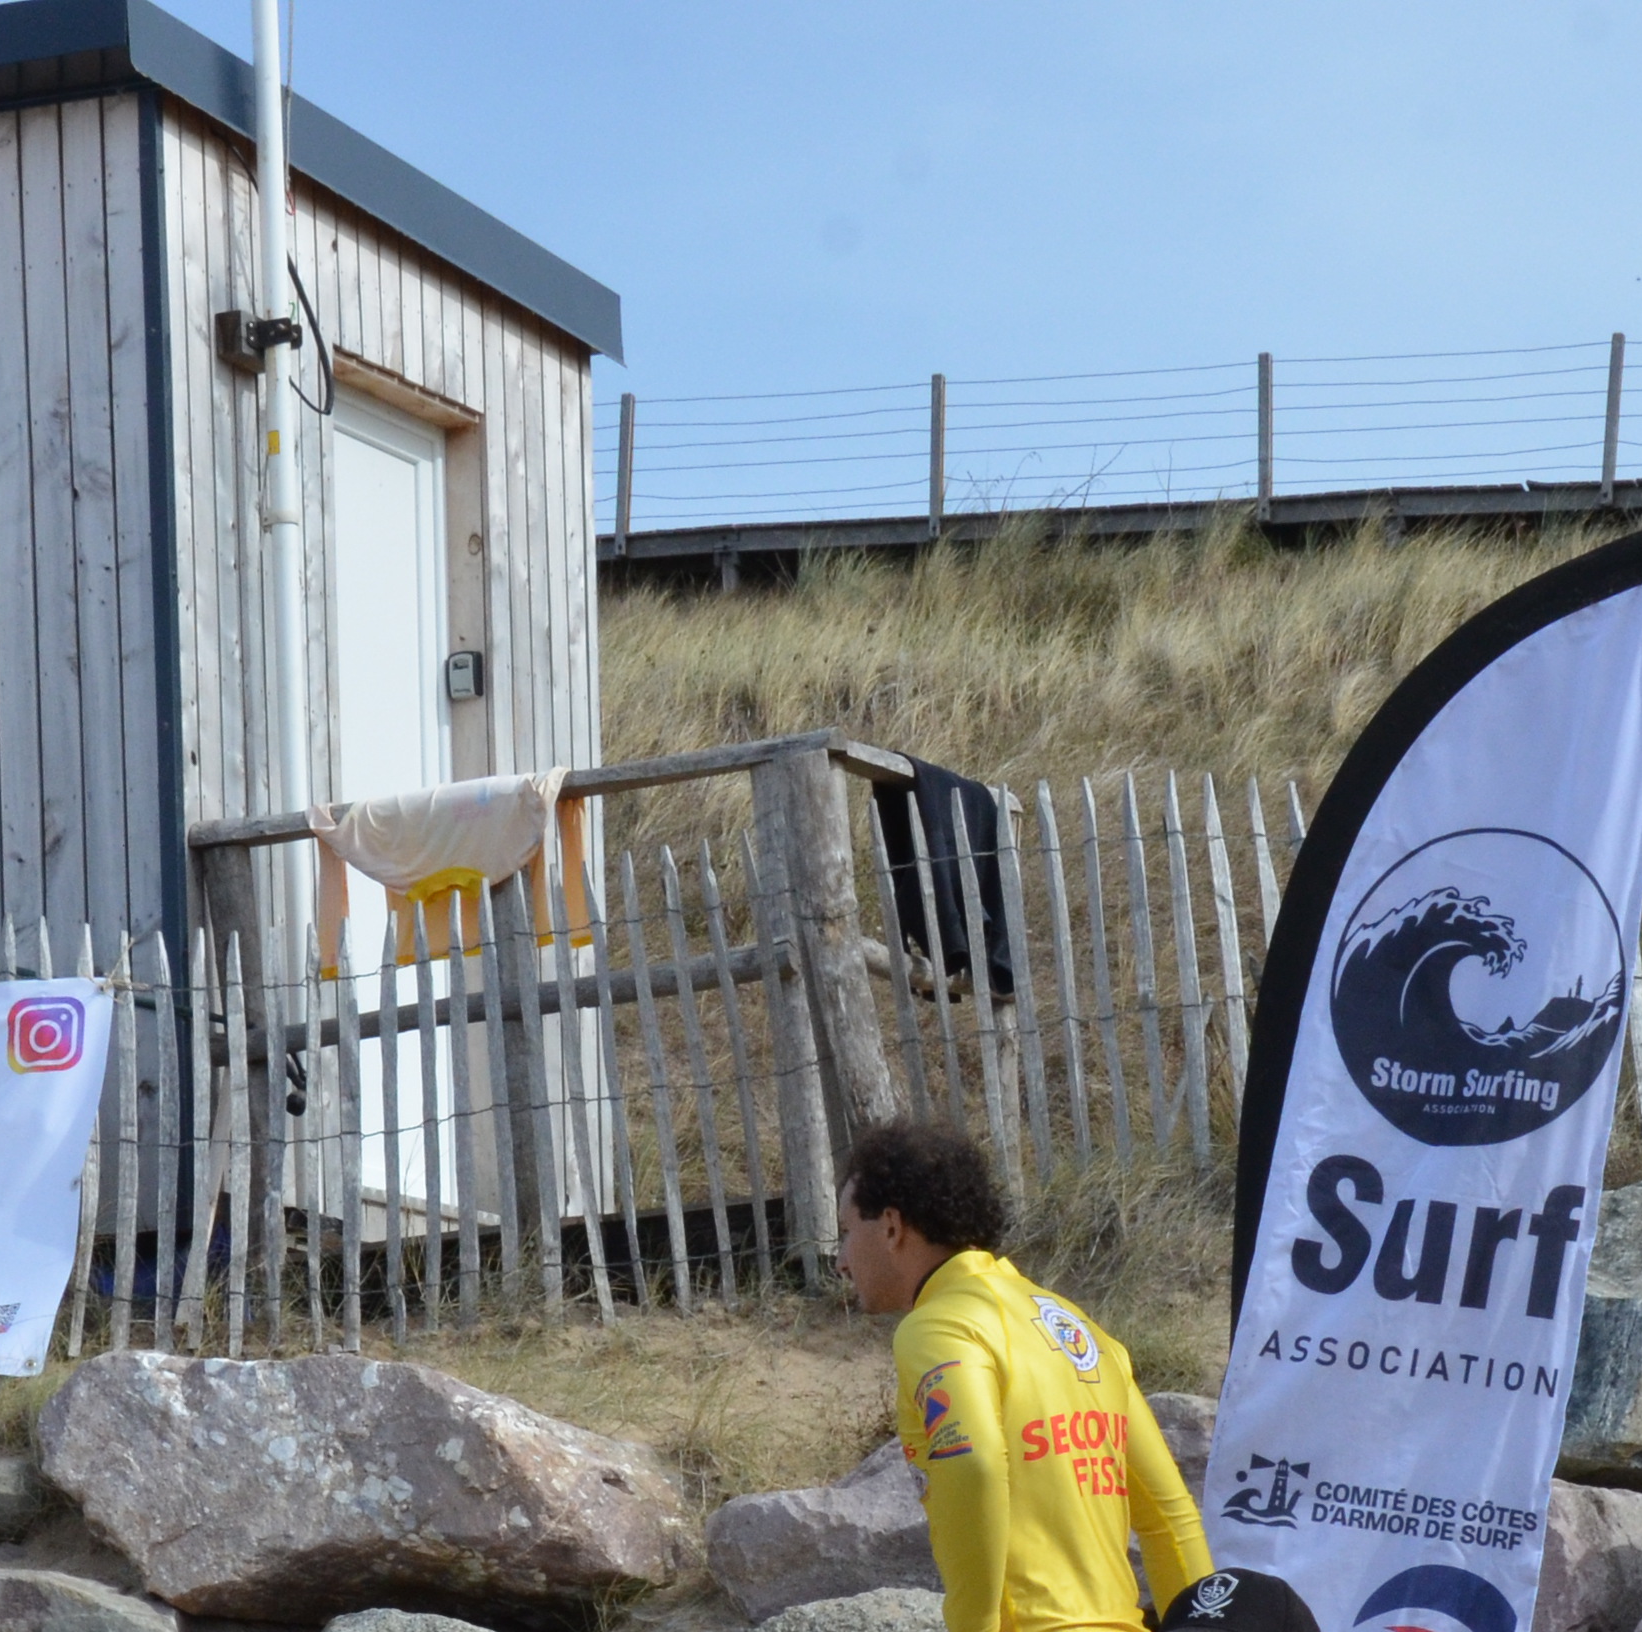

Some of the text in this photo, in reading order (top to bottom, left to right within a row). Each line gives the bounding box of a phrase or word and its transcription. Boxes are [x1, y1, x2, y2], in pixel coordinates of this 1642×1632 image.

[1371, 1057, 1560, 1111] Storm Surfing
[1423, 1104, 1496, 1114] ASSOCIATION
[1291, 1154, 1586, 1320] Surf
[1259, 1330, 1559, 1399] ASSOCIATION
[1021, 1410, 1128, 1461] SECOU
[1311, 1502, 1523, 1551] D'ARMOR DE SURF
[1315, 1481, 1537, 1531] COMITÉ DES CÔTES
